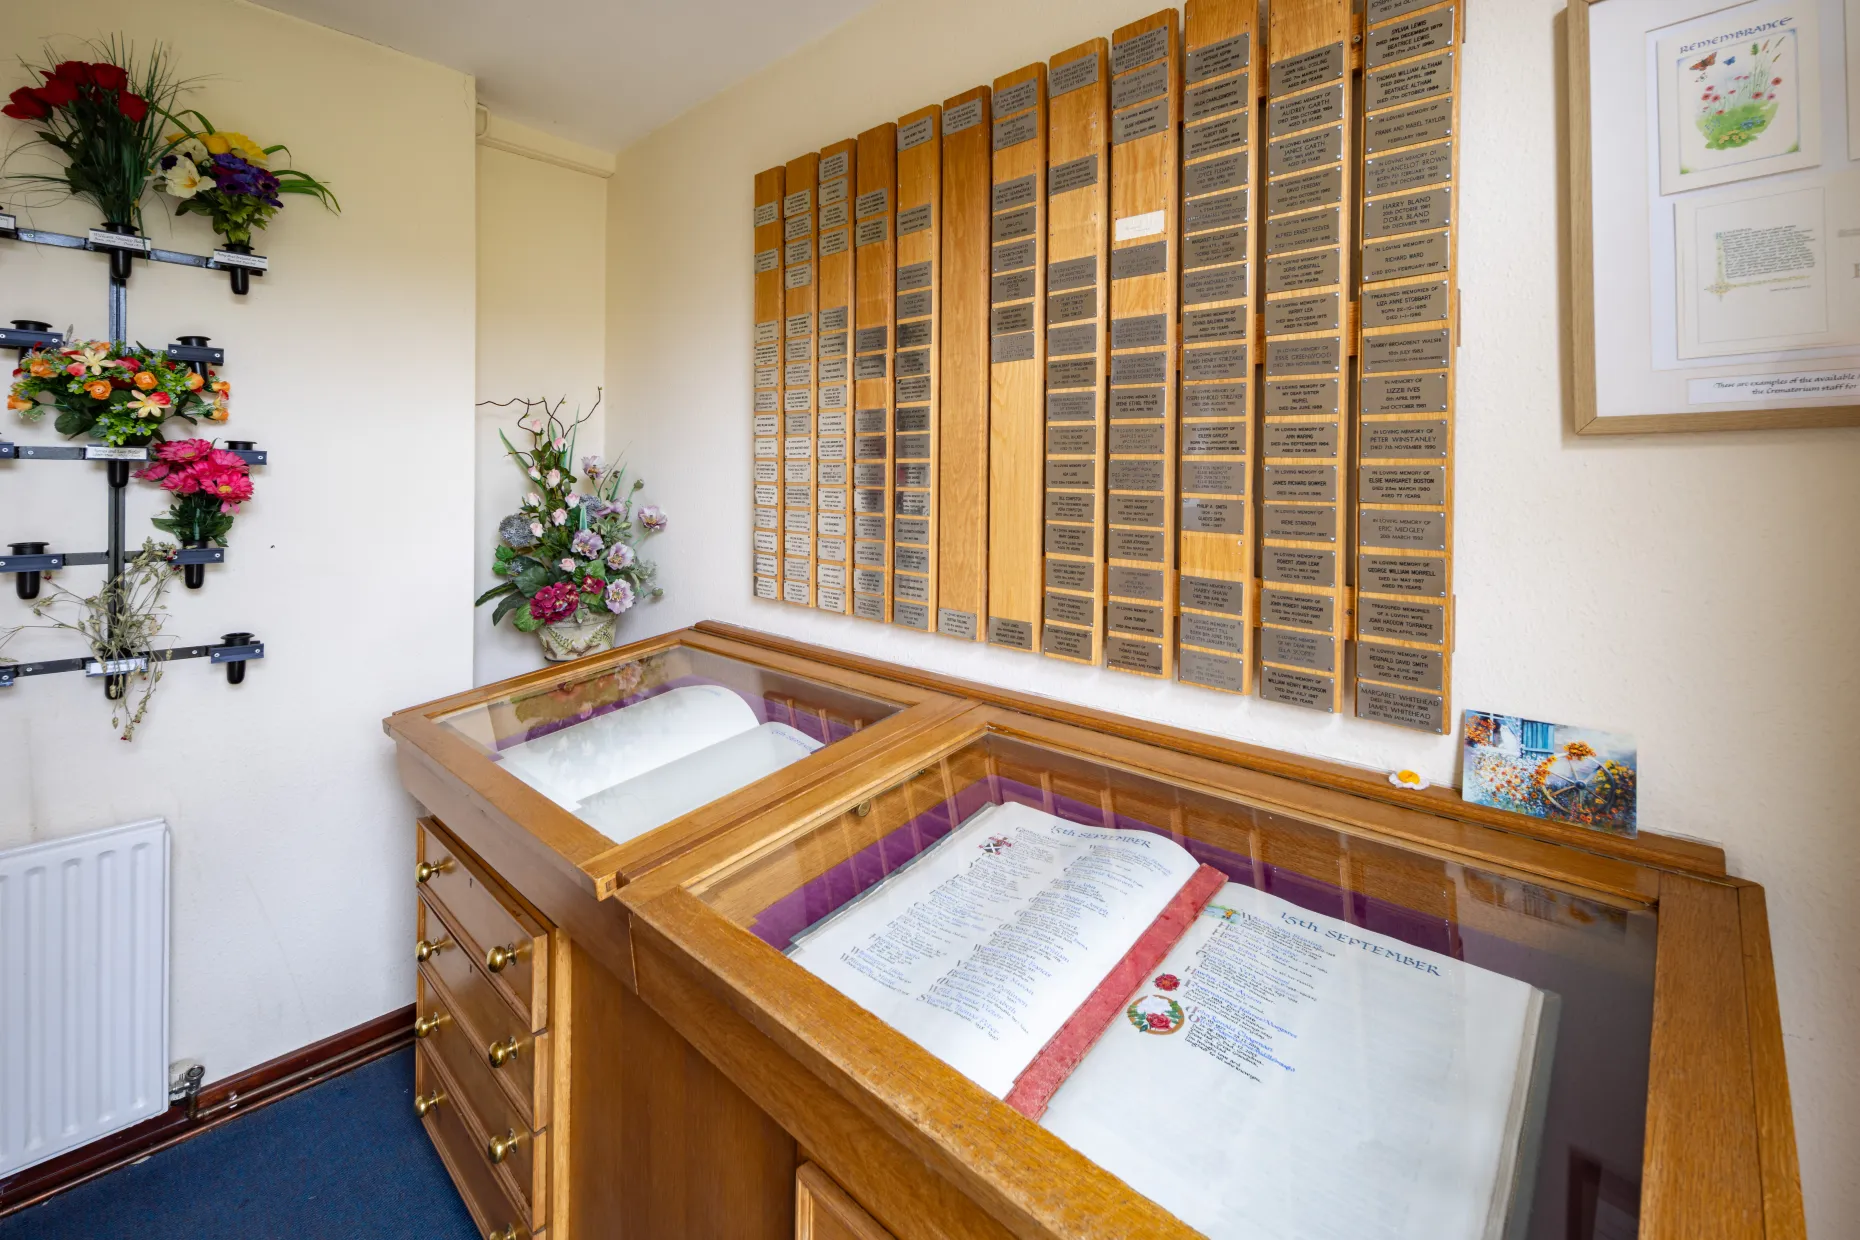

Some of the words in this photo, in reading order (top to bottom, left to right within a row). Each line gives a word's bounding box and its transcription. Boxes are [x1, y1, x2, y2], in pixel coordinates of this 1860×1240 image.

[1392, 26, 1409, 35] SYLVIA
[1411, 20, 1426, 29] LEWIS
[1401, 28, 1429, 40] DECEMBER
[1388, 39, 1411, 50] BEATRICE
[1414, 34, 1430, 42] LEWIS
[1377, 72, 1396, 82] THOMAS
[1398, 67, 1420, 77] WILLIAM
[1421, 60, 1442, 70] ALTHAM
[1384, 85, 1408, 95] BEATRICE
[1410, 79, 1431, 88] ALTHAM
[1401, 88, 1425, 98] OCTOBER
[1282, 106, 1305, 117] AUDREY
[1308, 99, 1329, 109] GARTH
[1386, 113, 1404, 122] LOVING
[1407, 108, 1428, 117] MEMORY
[1375, 127, 1392, 136] FRANK
[1394, 124, 1404, 132] AND
[1406, 120, 1422, 130] MABEL
[1425, 116, 1445, 124] TAYLOR
[1388, 134, 1414, 143] FEBRUARY
[1305, 142, 1325, 150] GARTH
[1388, 161, 1419, 173] LANCELOT
[1422, 156, 1448, 165] BROWN
[1382, 201, 1404, 210] HARRY
[1408, 196, 1431, 205] BLAND
[1383, 215, 1403, 223] DORA
[1406, 211, 1430, 219] BLAND
[1395, 207, 1417, 215] OCTOBER
[1398, 263, 1425, 272] FEBRUARY
[1371, 291, 1400, 300] TREASURED
[1402, 288, 1430, 296] MEMORIES
[1750, 379, 1787, 389] examples
[1814, 374, 1855, 382] available
[1766, 386, 1820, 394] Crematorium
[1369, 655, 1394, 663] REGINALD
[1361, 688, 1396, 699] MARGARET
[1399, 694, 1439, 707] WHITEHEAD
[1369, 702, 1388, 713] JAMES
[1391, 708, 1431, 720] WHITEHEAD
[1078, 832, 1151, 848] SEPTEMBER
[1281, 912, 1318, 932] 15th
[1325, 929, 1441, 976] SEPTEMBER
